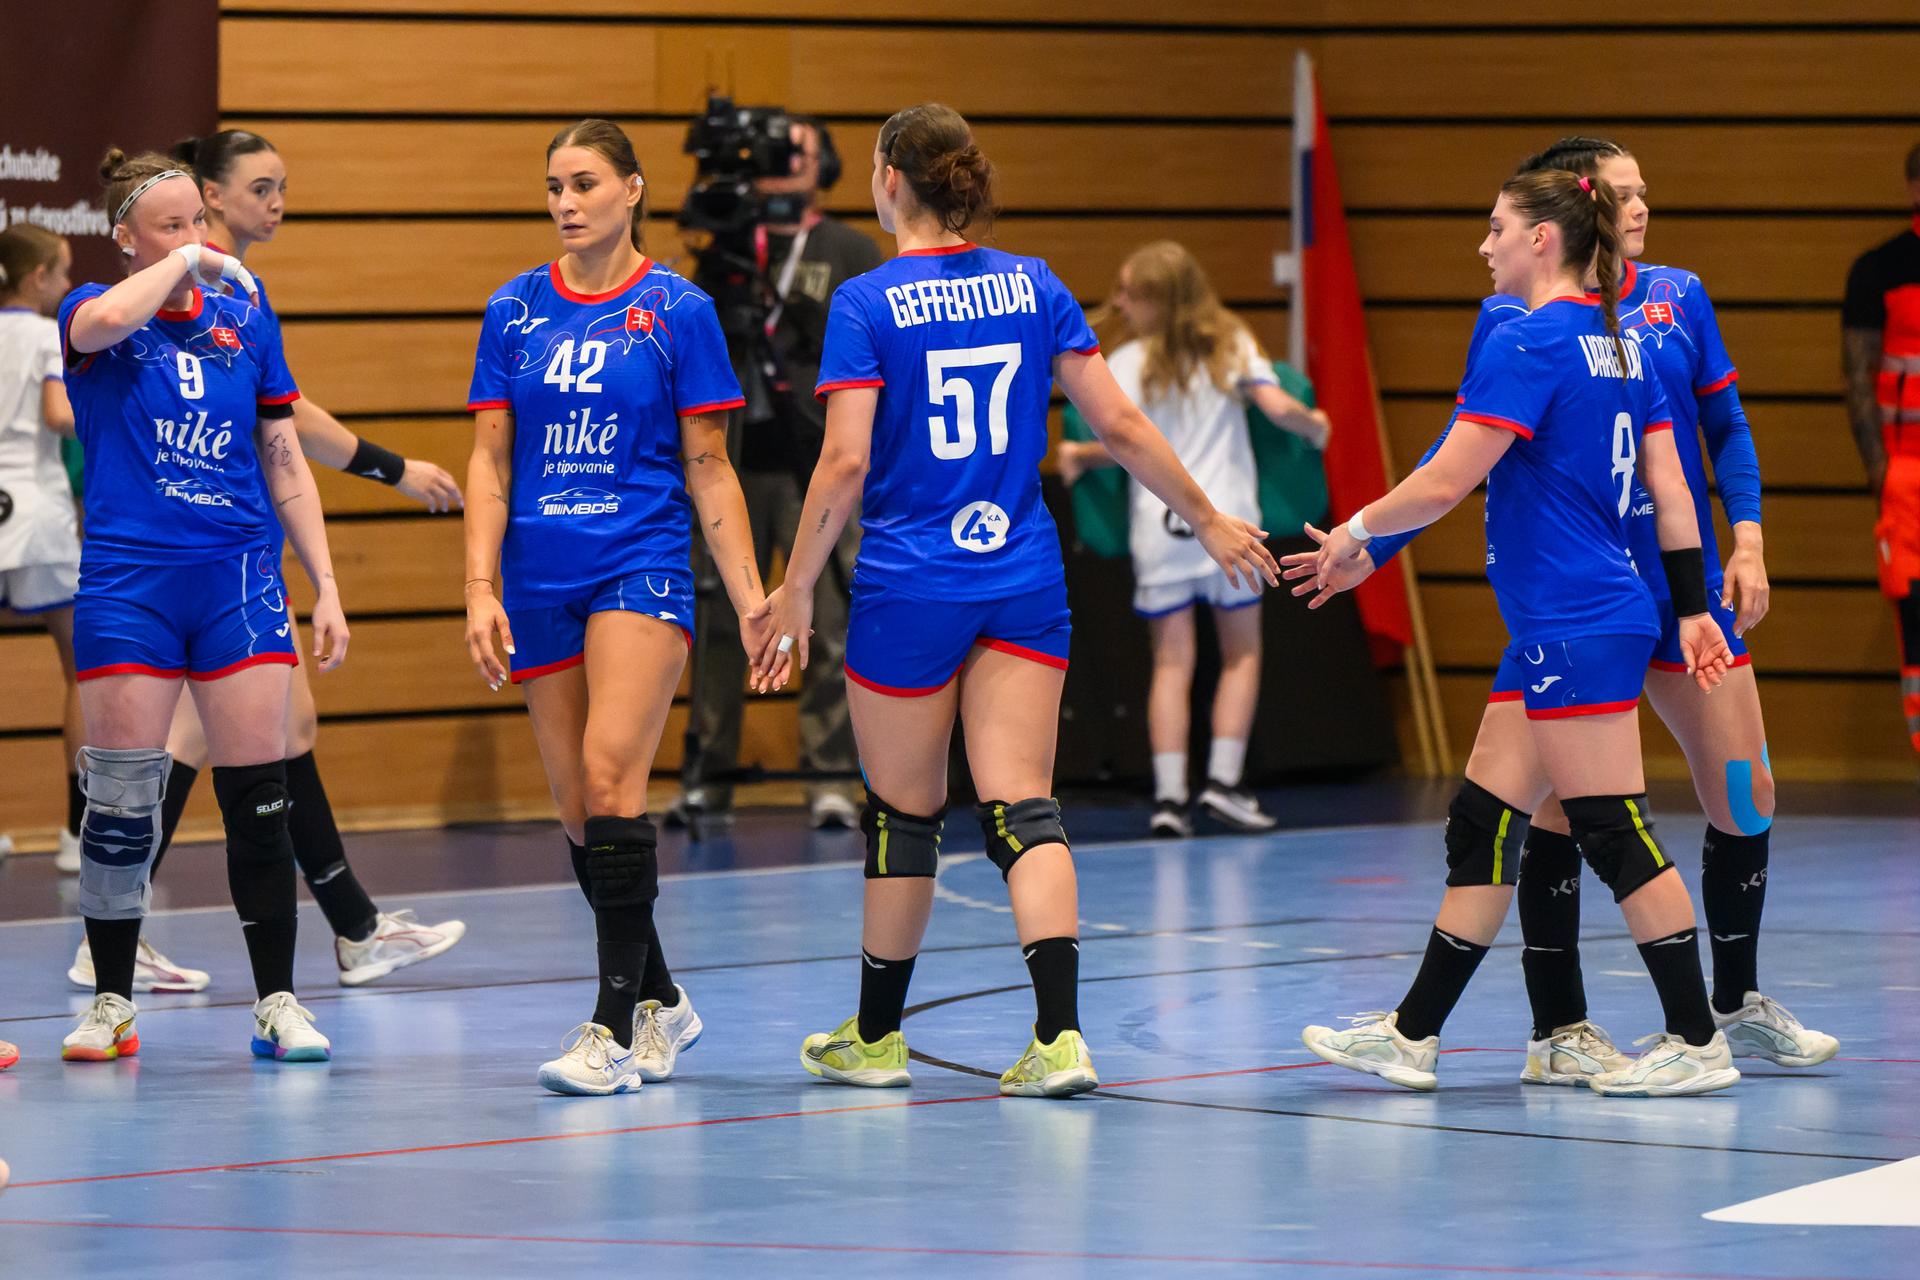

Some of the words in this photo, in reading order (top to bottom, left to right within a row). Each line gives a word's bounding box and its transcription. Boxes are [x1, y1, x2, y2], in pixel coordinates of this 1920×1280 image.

[885, 264, 1037, 328] GEFFERTOVÁ
[176, 351, 205, 399] 9
[543, 340, 607, 393] 42
[1578, 329, 1644, 381] VARGVÁ
[926, 342, 1023, 460] 57
[153, 411, 233, 460] niké
[543, 407, 619, 455] niké
[155, 448, 169, 465] je
[542, 460, 555, 477] je
[556, 460, 615, 477] tipovanie
[562, 502, 619, 515] MBDS
[960, 510, 996, 545] 4
[987, 514, 1002, 522] KA
[256, 799, 284, 814] SELECT
